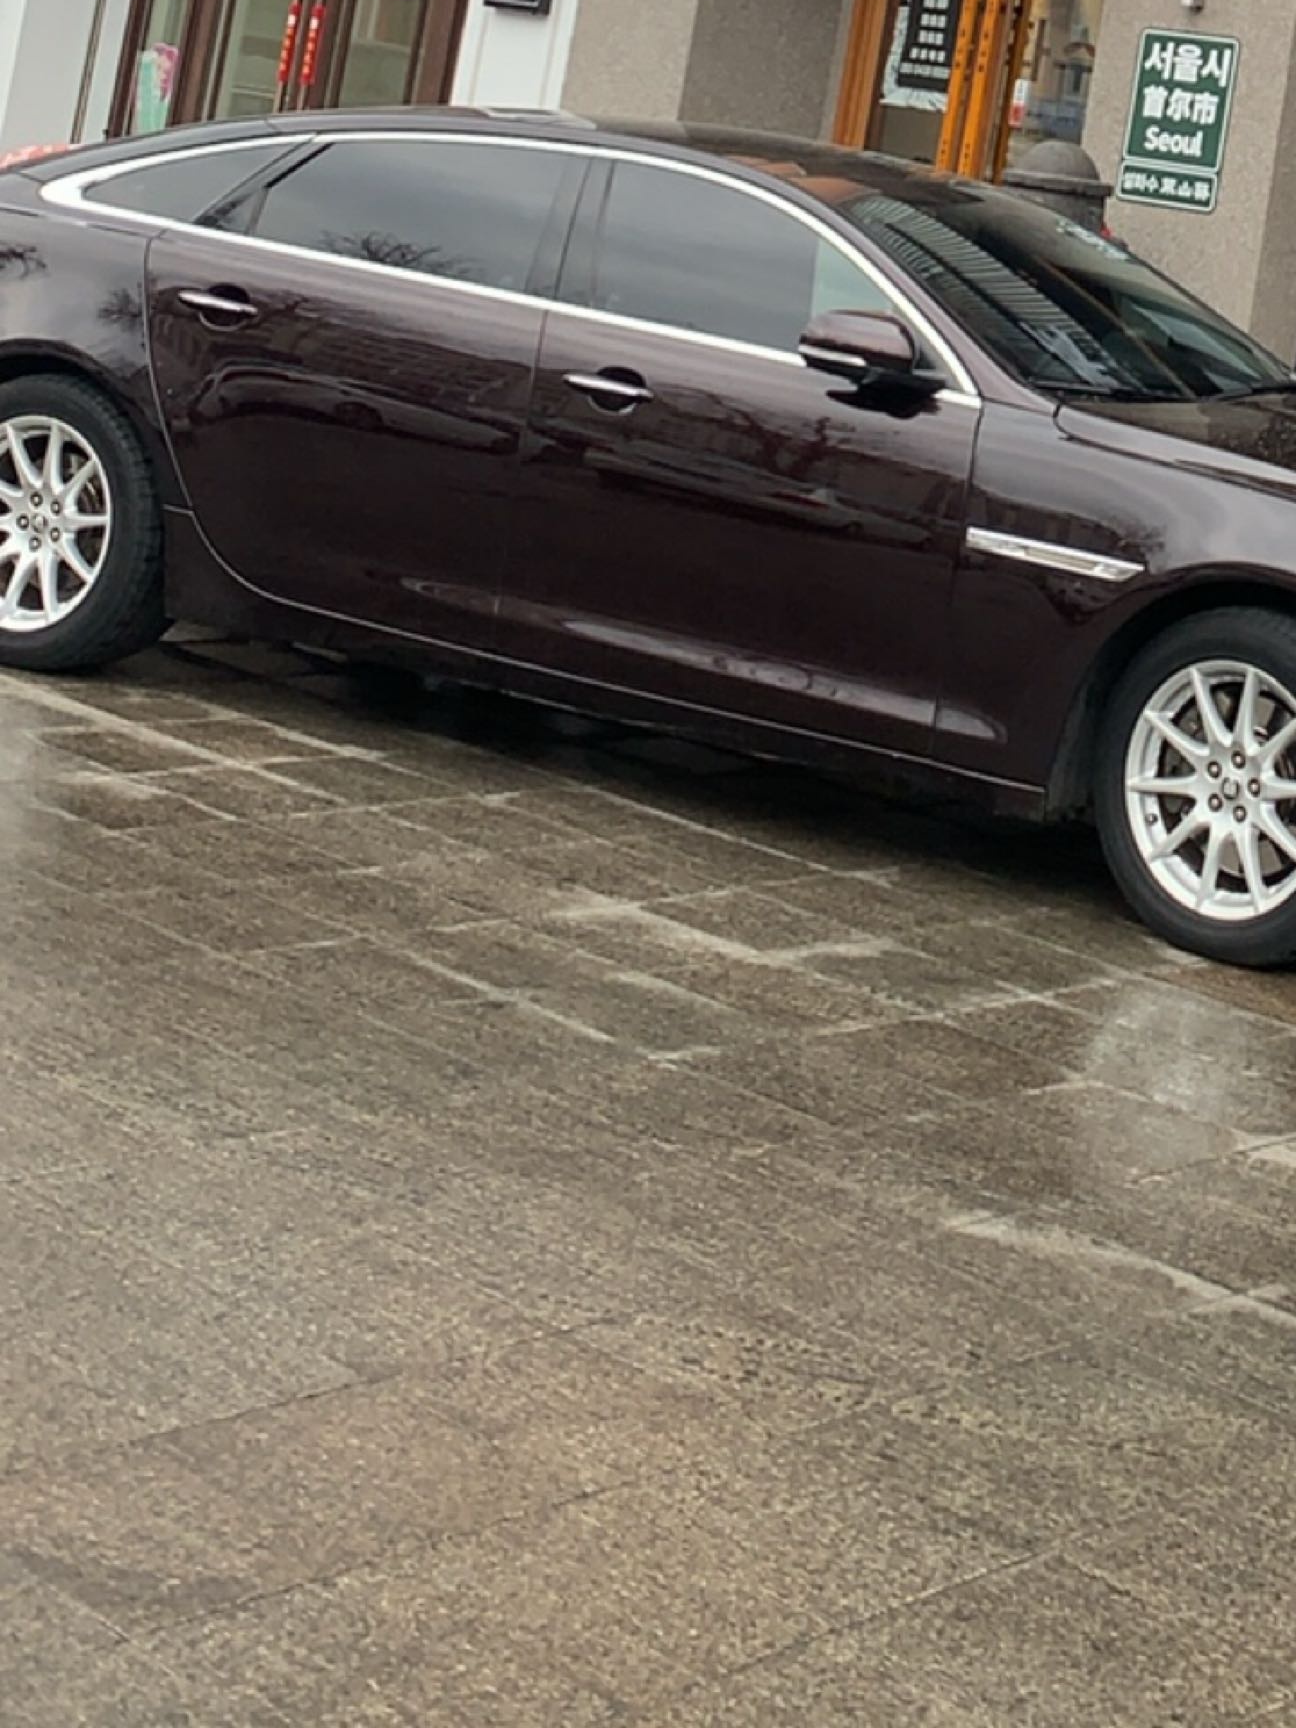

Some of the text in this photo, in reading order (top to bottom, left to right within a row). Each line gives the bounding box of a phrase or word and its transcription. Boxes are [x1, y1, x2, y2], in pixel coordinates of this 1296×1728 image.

[1144, 41, 1232, 88] 서울시
[1143, 84, 1220, 125] 首尔市
[1143, 124, 1204, 157] Seoul
